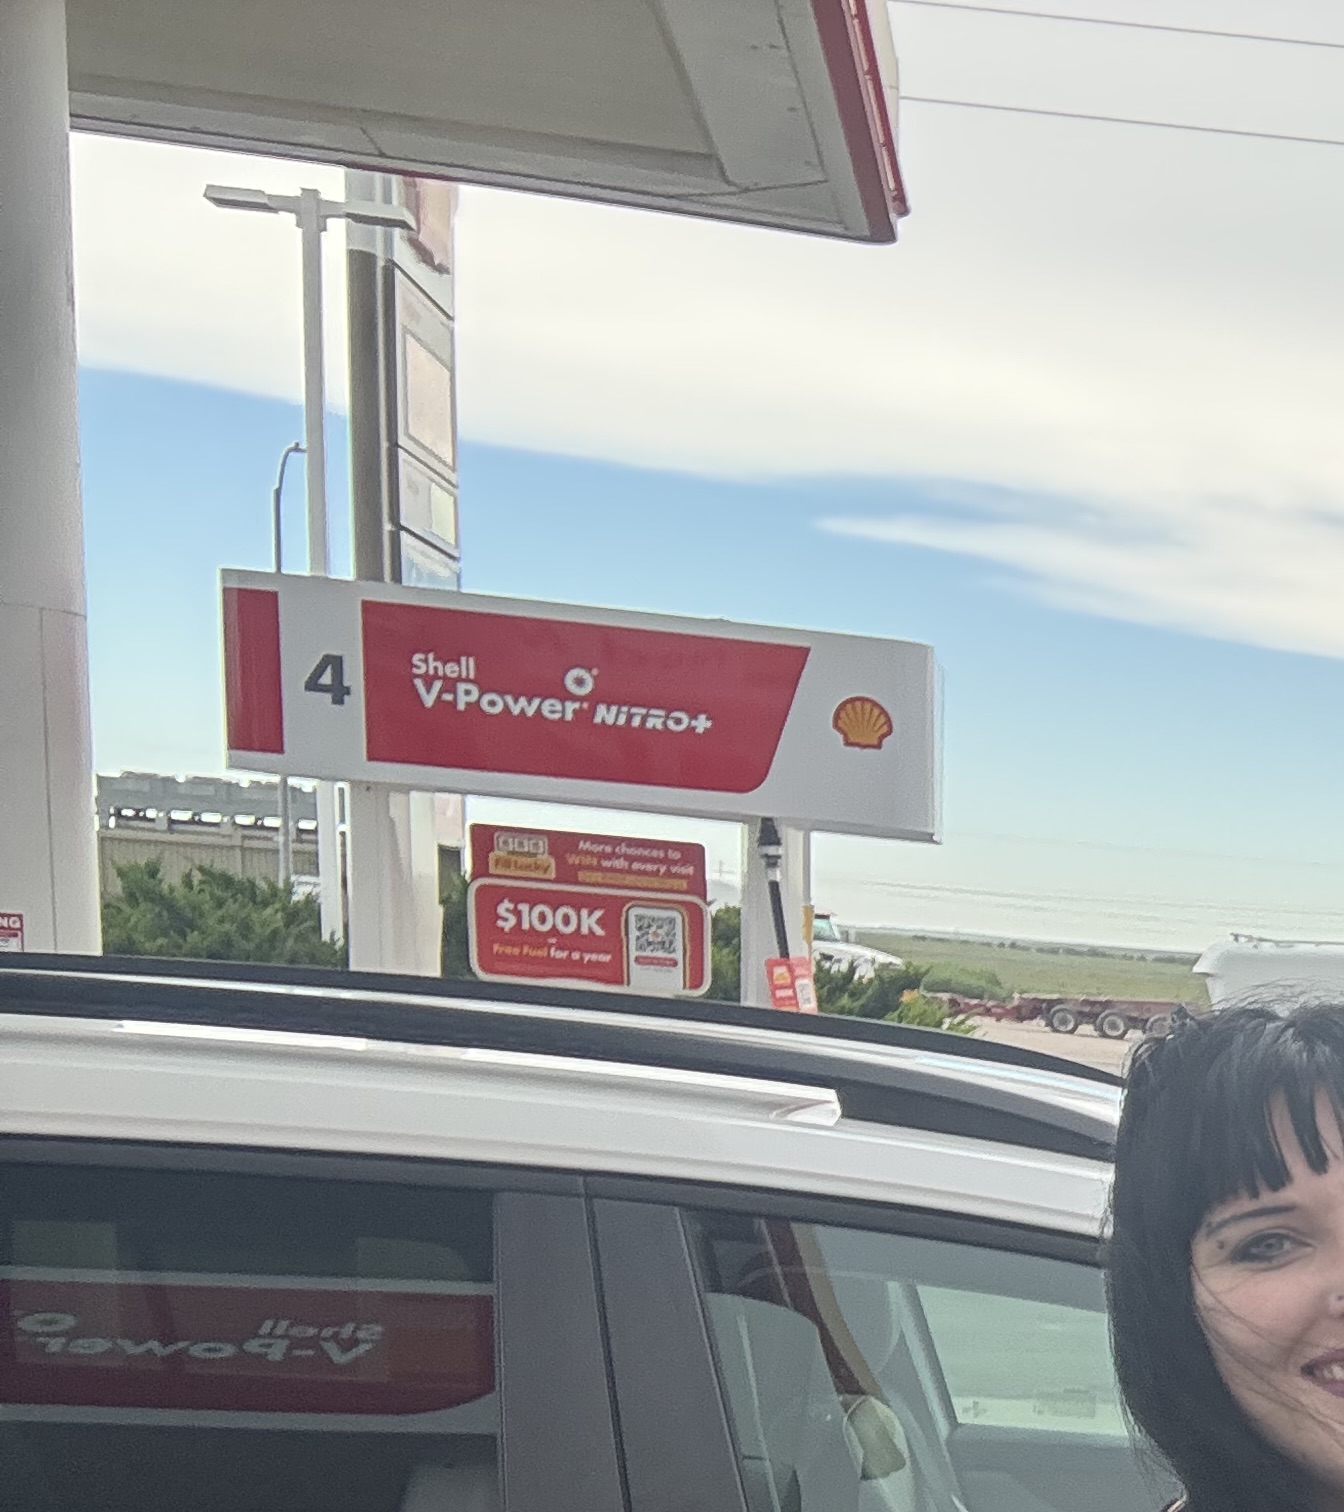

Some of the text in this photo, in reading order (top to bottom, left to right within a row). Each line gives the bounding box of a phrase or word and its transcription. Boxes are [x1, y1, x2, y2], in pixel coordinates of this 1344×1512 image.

[304, 653, 352, 706] 4
[411, 652, 476, 680] Shell
[413, 677, 581, 722] V-Power
[578, 839, 682, 860] More chances to
[601, 854, 630, 870] with
[631, 859, 667, 876] every
[669, 862, 695, 876] visit
[495, 897, 606, 937] $100K
[549, 945, 569, 960] for
[571, 951, 580, 961] a
[582, 952, 612, 965] year
